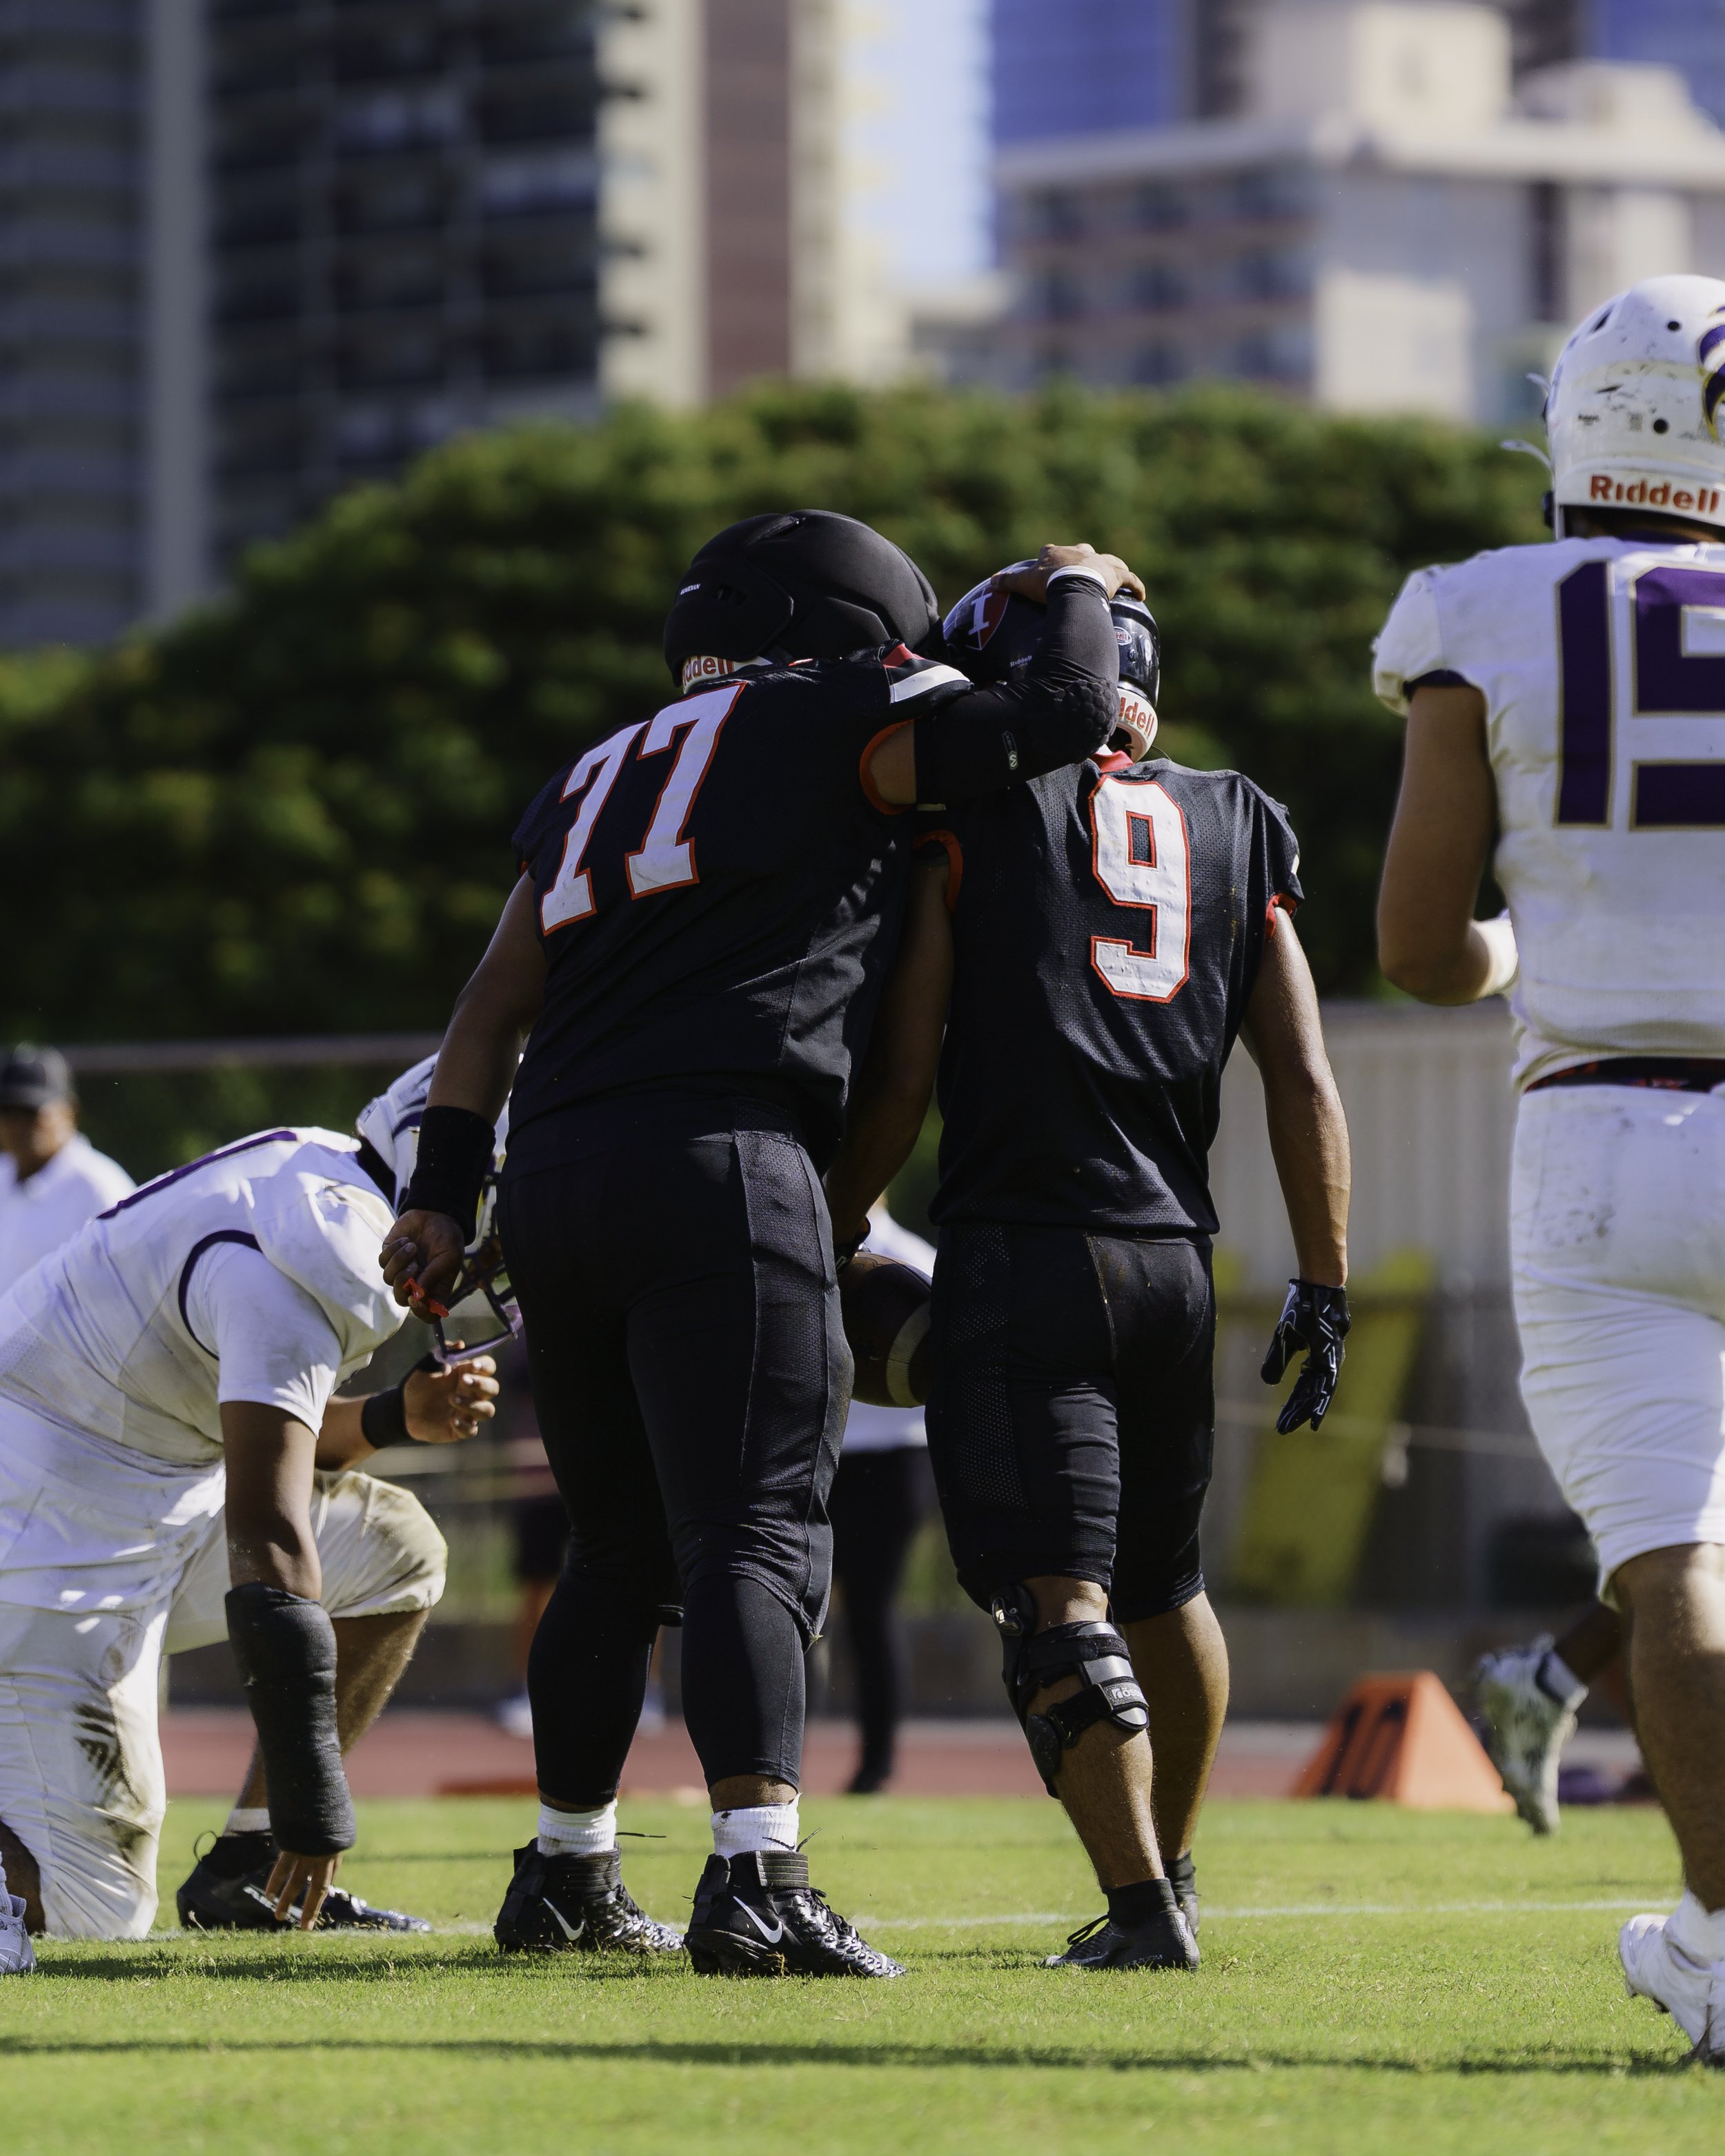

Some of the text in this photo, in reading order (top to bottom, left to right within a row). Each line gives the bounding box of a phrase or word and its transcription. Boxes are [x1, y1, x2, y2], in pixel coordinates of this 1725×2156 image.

[1590, 474, 1719, 513] Riddell
[682, 654, 734, 687] iddell
[540, 680, 747, 937] 77
[1088, 775, 1192, 1004] 9
